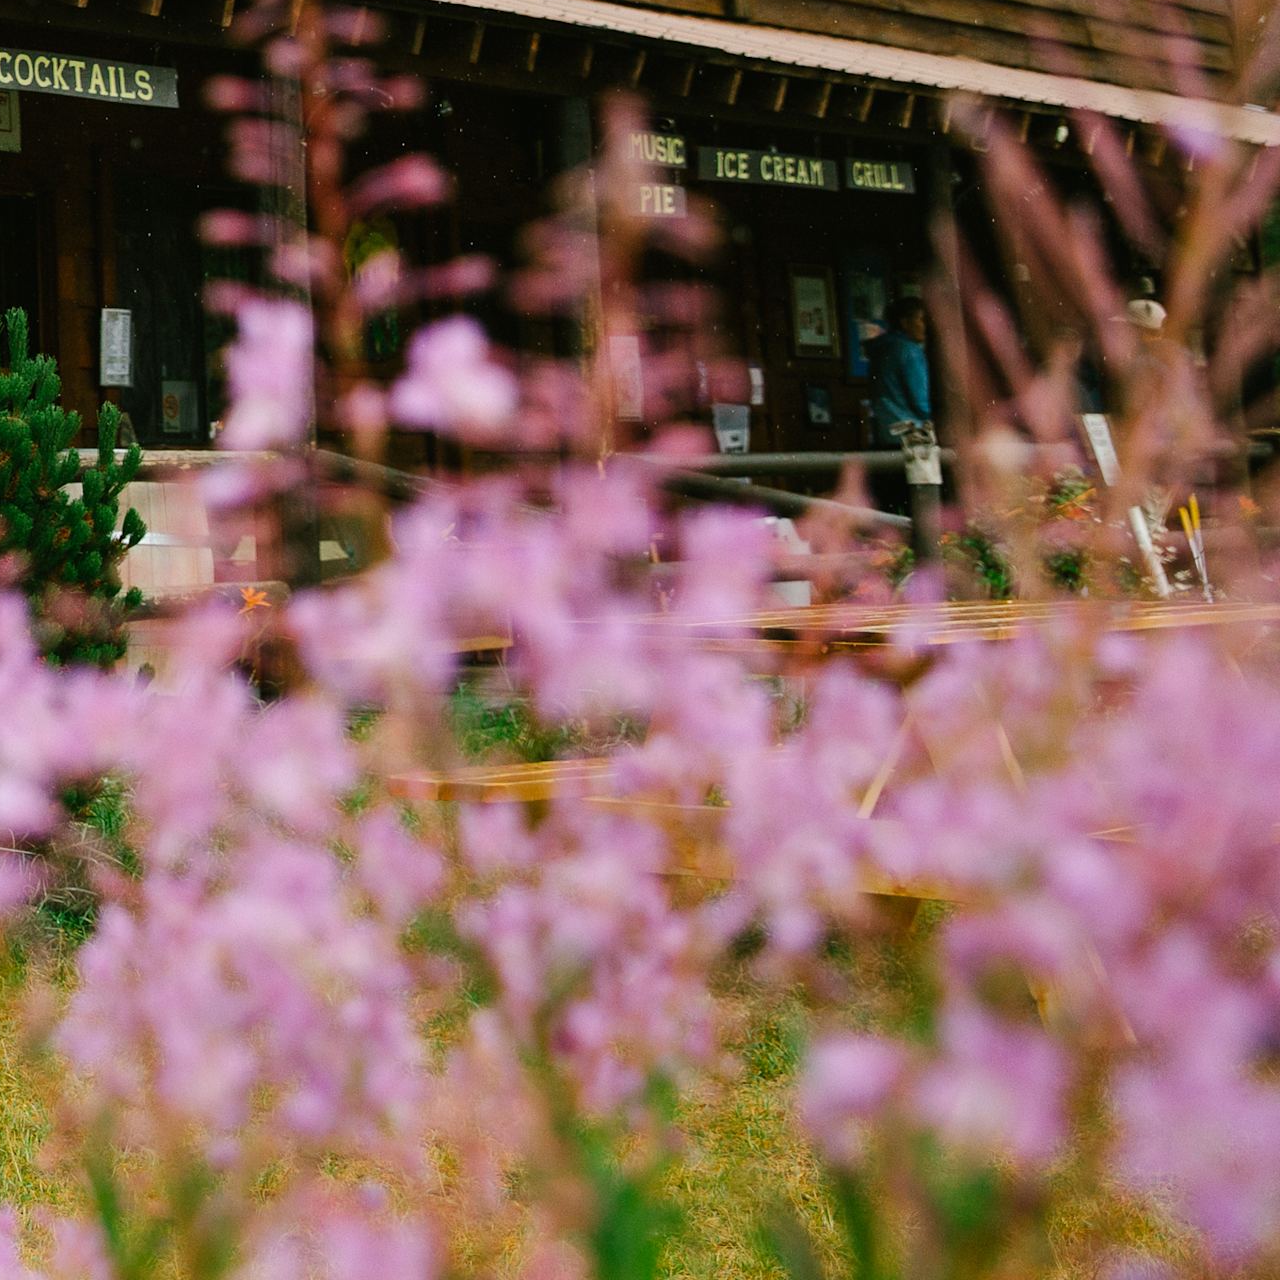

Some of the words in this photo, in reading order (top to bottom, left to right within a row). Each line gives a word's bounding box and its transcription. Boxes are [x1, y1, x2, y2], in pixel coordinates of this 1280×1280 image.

[627, 132, 685, 165] MUSIC
[716, 151, 751, 179] ICE
[760, 154, 825, 186] CREAM
[852, 161, 906, 190] GRILL
[640, 185, 675, 214] PIE
